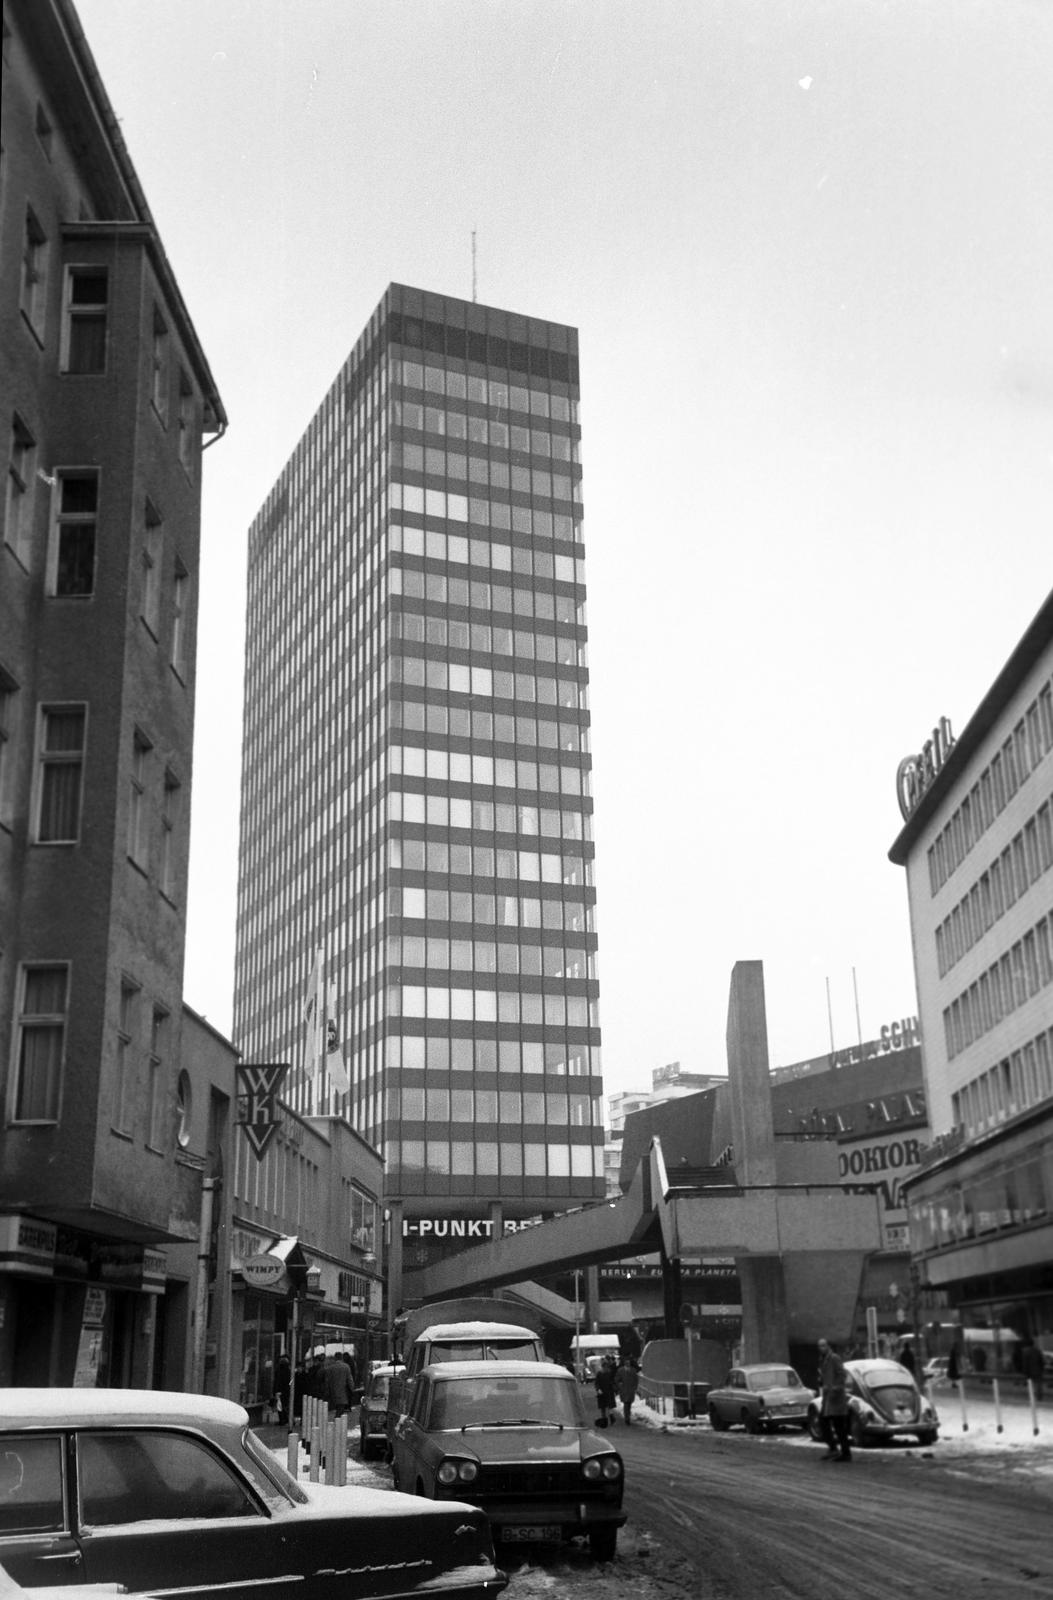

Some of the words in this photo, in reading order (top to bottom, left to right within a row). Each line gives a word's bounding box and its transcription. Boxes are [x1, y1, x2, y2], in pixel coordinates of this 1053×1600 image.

[402, 1219, 494, 1236] I-PUNKT
[246, 1264, 281, 1273] WIMPY
[601, 1268, 637, 1277] BERLIN
